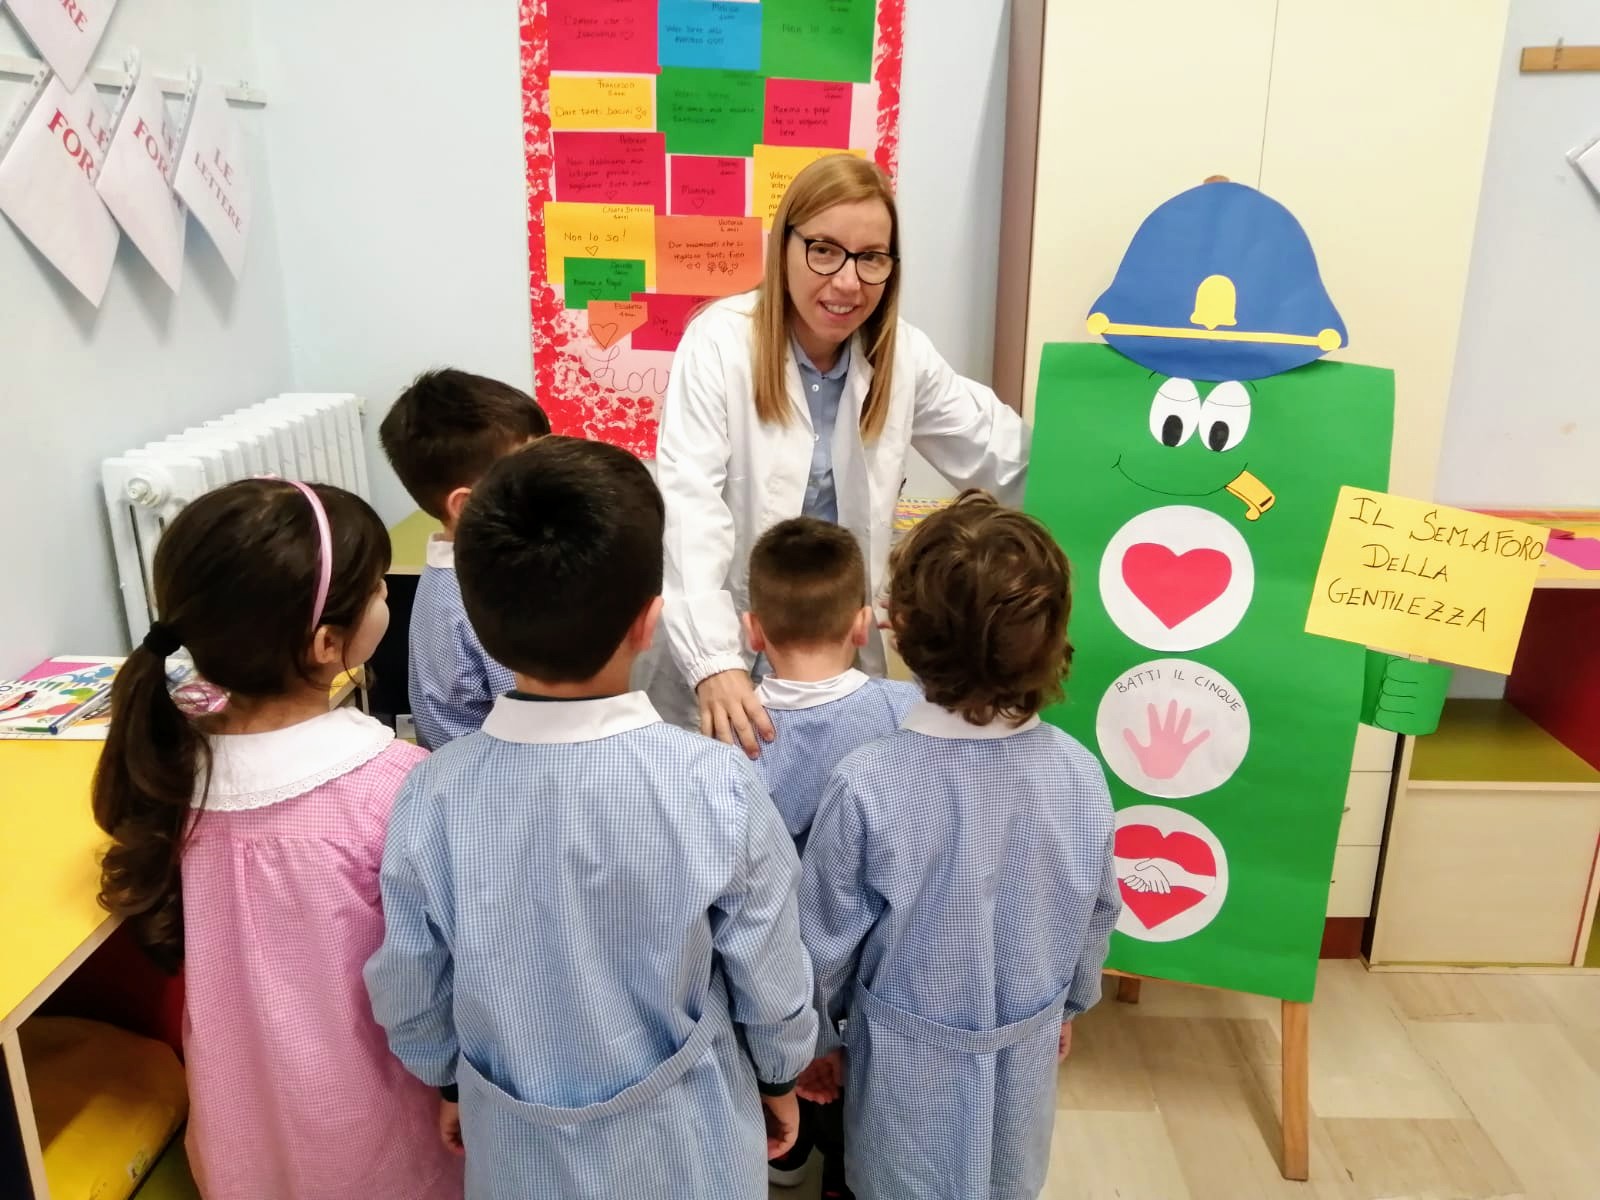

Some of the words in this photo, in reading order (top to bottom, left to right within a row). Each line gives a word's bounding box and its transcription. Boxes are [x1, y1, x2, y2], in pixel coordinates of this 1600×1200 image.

[214, 147, 233, 186] LE
[194, 151, 242, 234] LETTERE
[564, 231, 583, 241] Non
[590, 231, 599, 241] lo
[1349, 497, 1394, 529] IL
[1361, 543, 1448, 583] DELLA
[1327, 577, 1487, 632] GENTILEZZA
[1115, 669, 1161, 693] BATTI
[1173, 669, 1185, 681] IL
[1194, 676, 1242, 712] CINQUE
